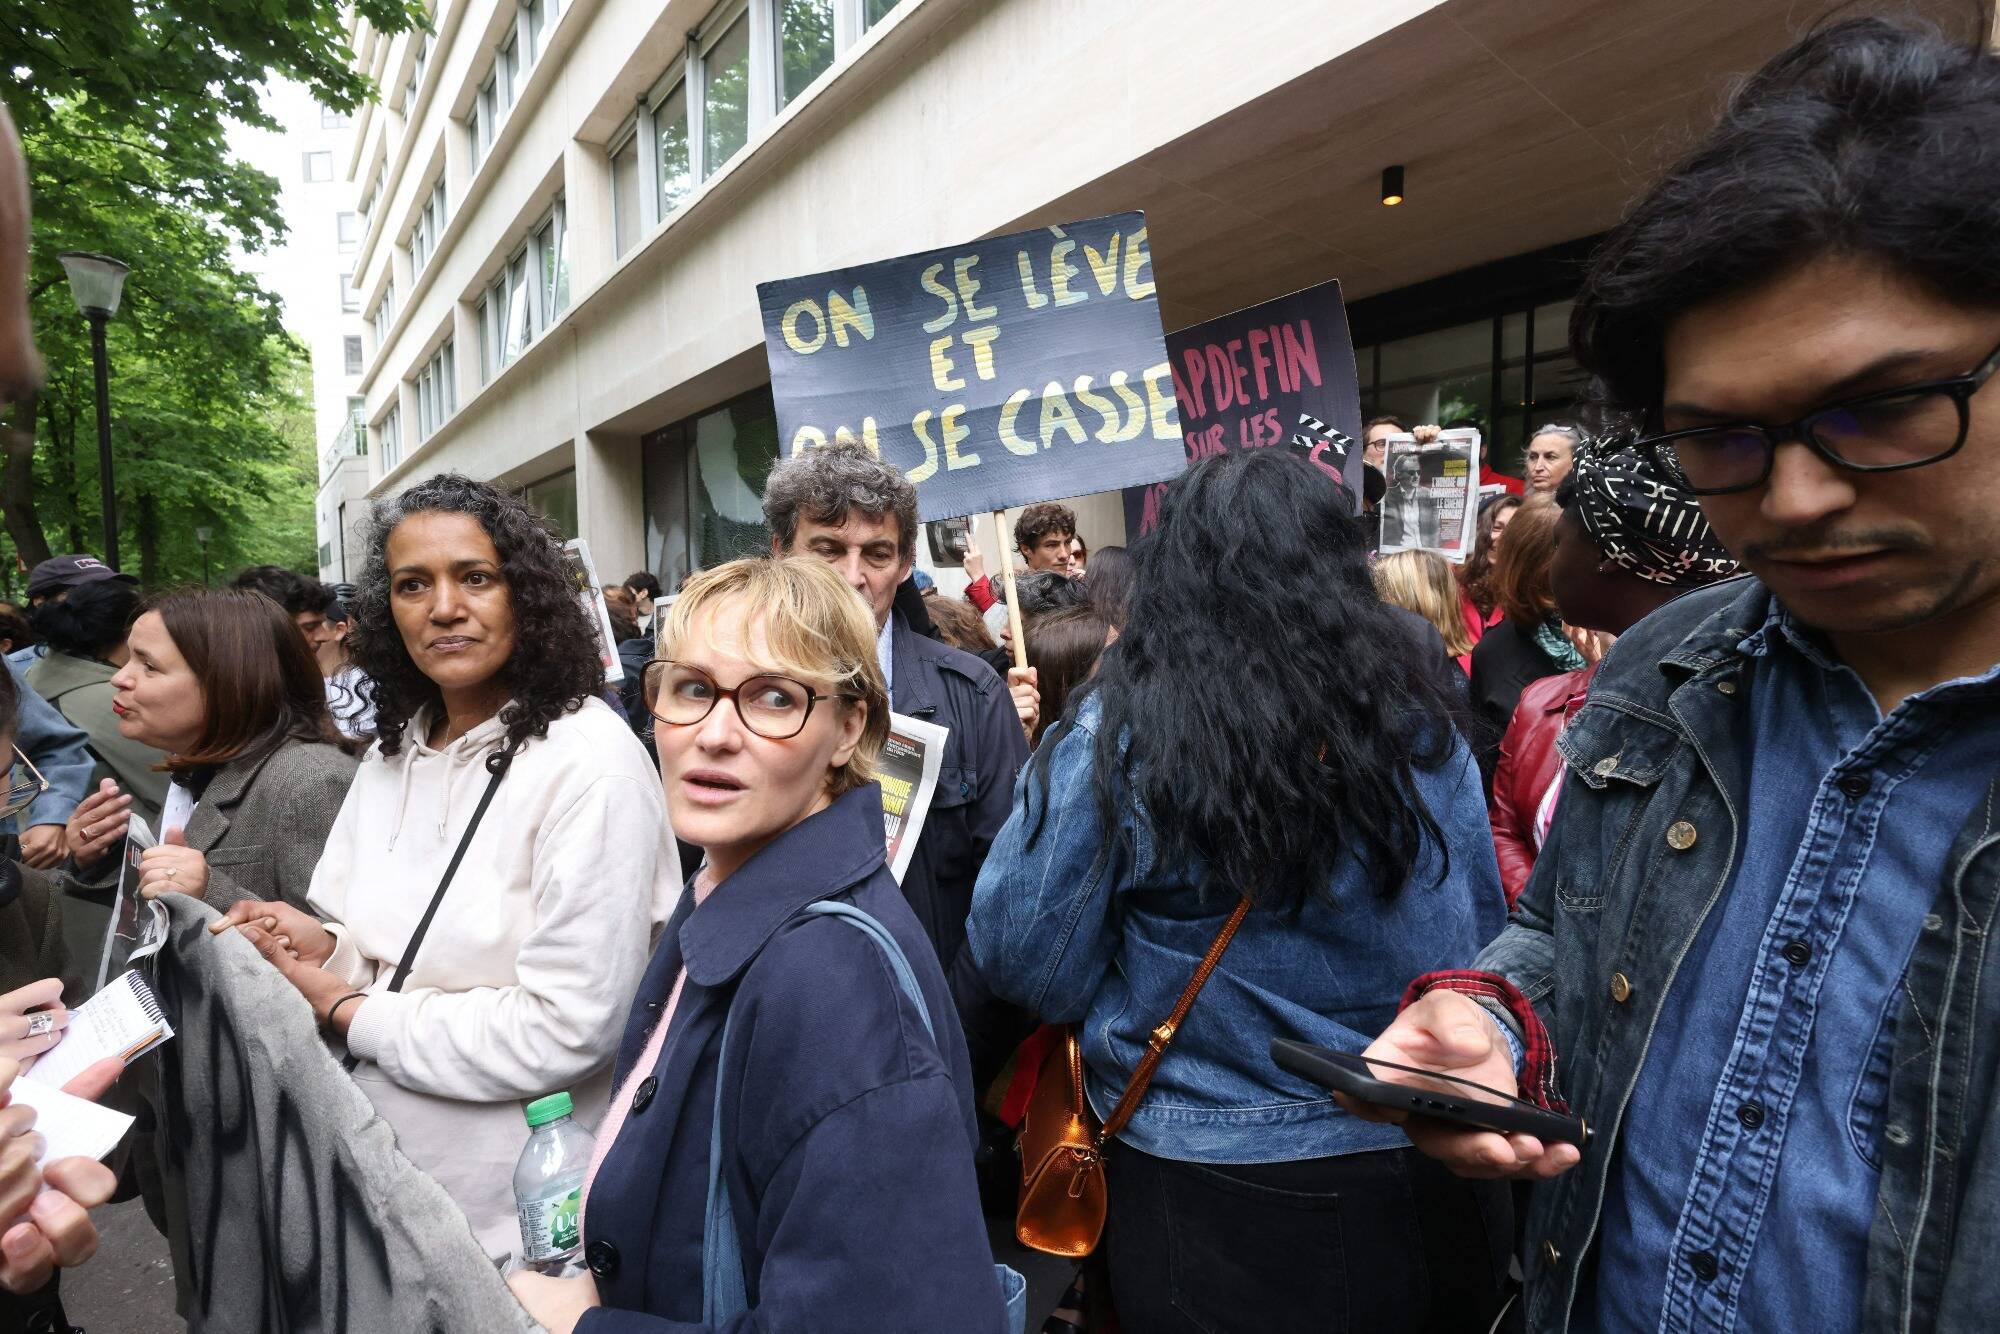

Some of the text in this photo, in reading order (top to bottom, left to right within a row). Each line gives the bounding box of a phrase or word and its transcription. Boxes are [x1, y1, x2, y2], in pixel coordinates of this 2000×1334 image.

[782, 225, 1157, 354] ON SE LÈVE
[929, 325, 1001, 392] ET
[904, 403, 981, 484] SE
[997, 362, 1183, 457] CASSE
[1186, 407, 1283, 464] SUR LES
